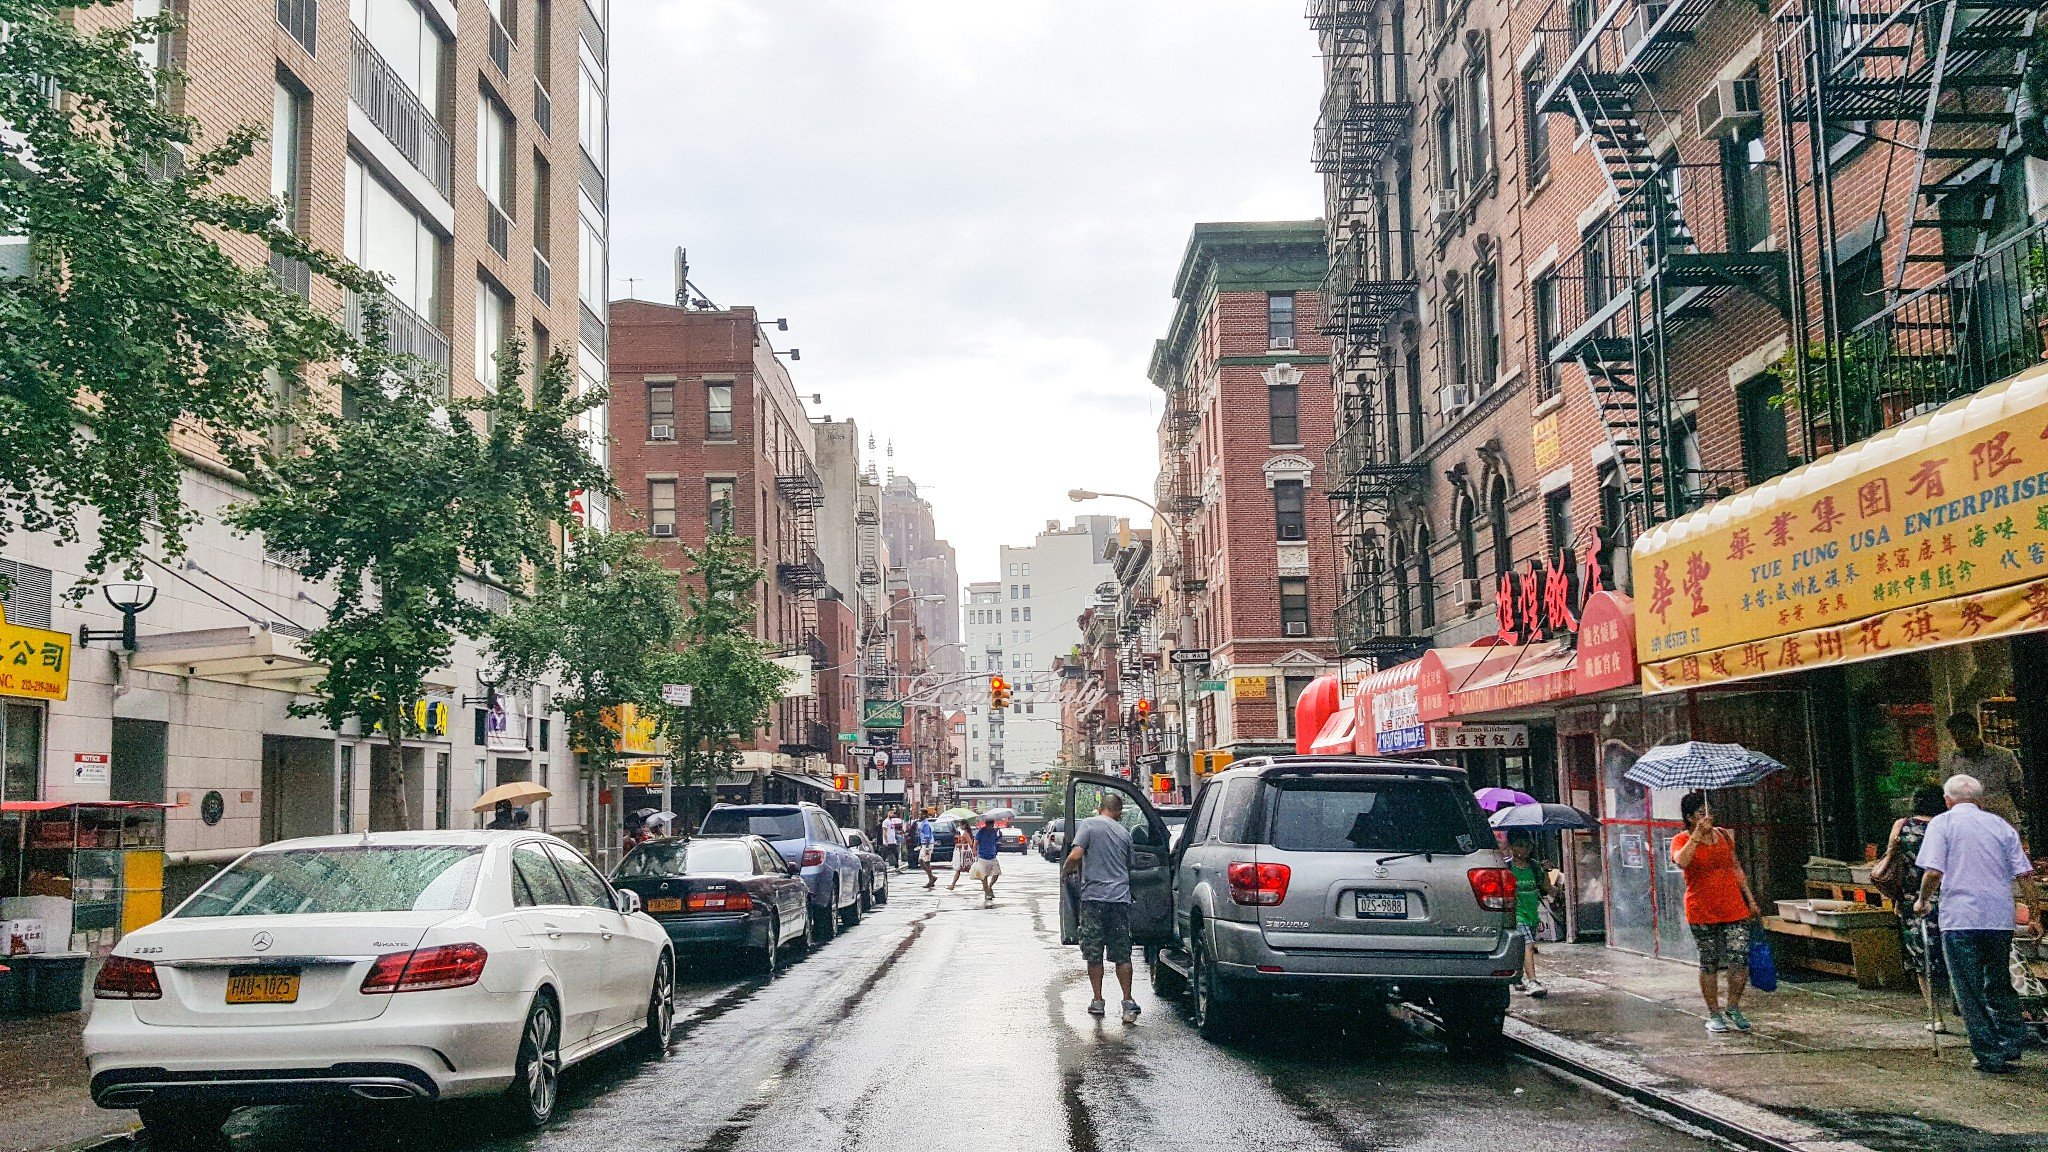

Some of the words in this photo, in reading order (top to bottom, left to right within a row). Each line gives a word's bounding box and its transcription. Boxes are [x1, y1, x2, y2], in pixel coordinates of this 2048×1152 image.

[1750, 558, 1782, 584] YUE
[1791, 540, 1840, 571] FUNG
[1850, 524, 1892, 552] USA
[1903, 471, 2048, 537] ENTERPRISE
[0, 640, 64, 673] 公司
